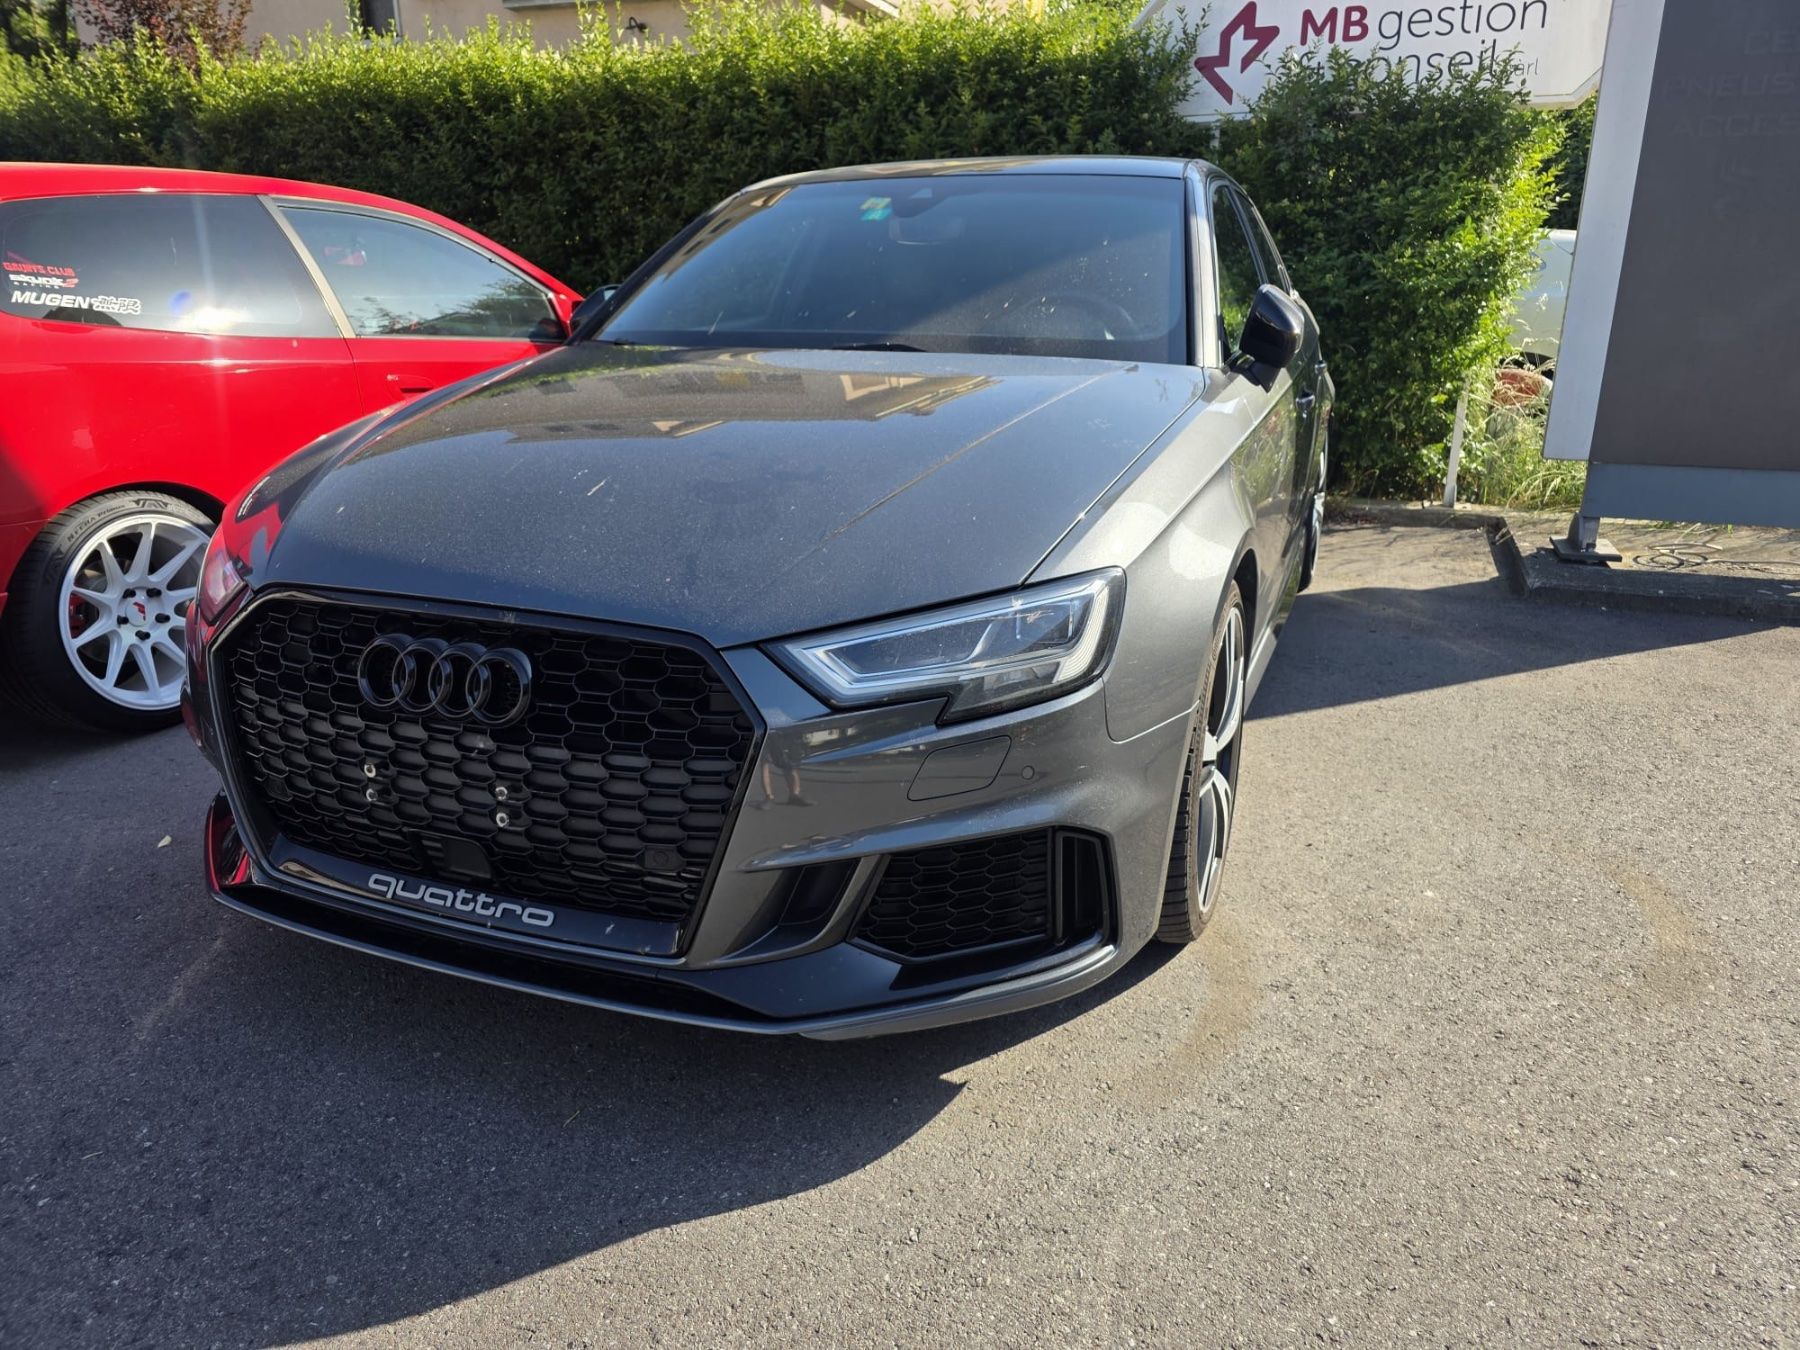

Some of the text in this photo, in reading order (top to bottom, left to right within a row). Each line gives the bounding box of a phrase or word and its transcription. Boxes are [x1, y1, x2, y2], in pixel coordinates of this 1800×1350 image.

[1299, 0, 1547, 50] MB gestion
[11, 290, 90, 309] MUGEN
[368, 873, 555, 927] quattro
